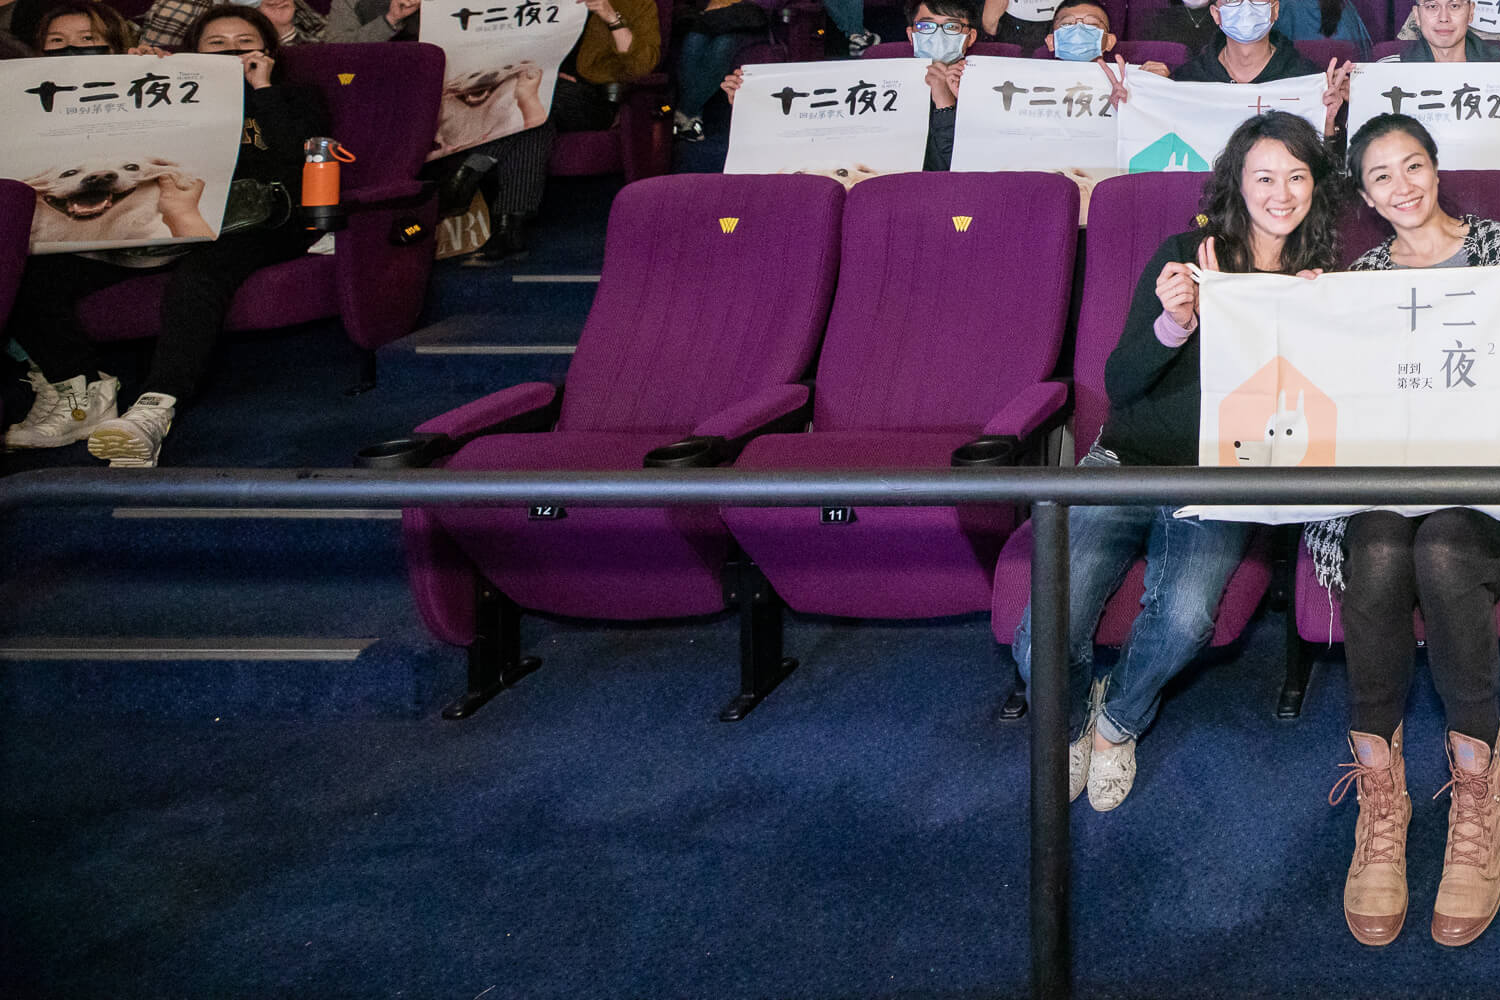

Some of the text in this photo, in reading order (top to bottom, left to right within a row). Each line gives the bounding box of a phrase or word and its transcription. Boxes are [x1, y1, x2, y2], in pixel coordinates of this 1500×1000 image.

[450, 0, 560, 31] 十二夜2
[24, 72, 200, 113] 十二夜2
[770, 79, 899, 116] 十二夜2
[991, 79, 1113, 119] 十二夜2
[1397, 362, 1421, 375] 回到
[1397, 377, 1433, 390] 第零天
[829, 509, 842, 520] 11
